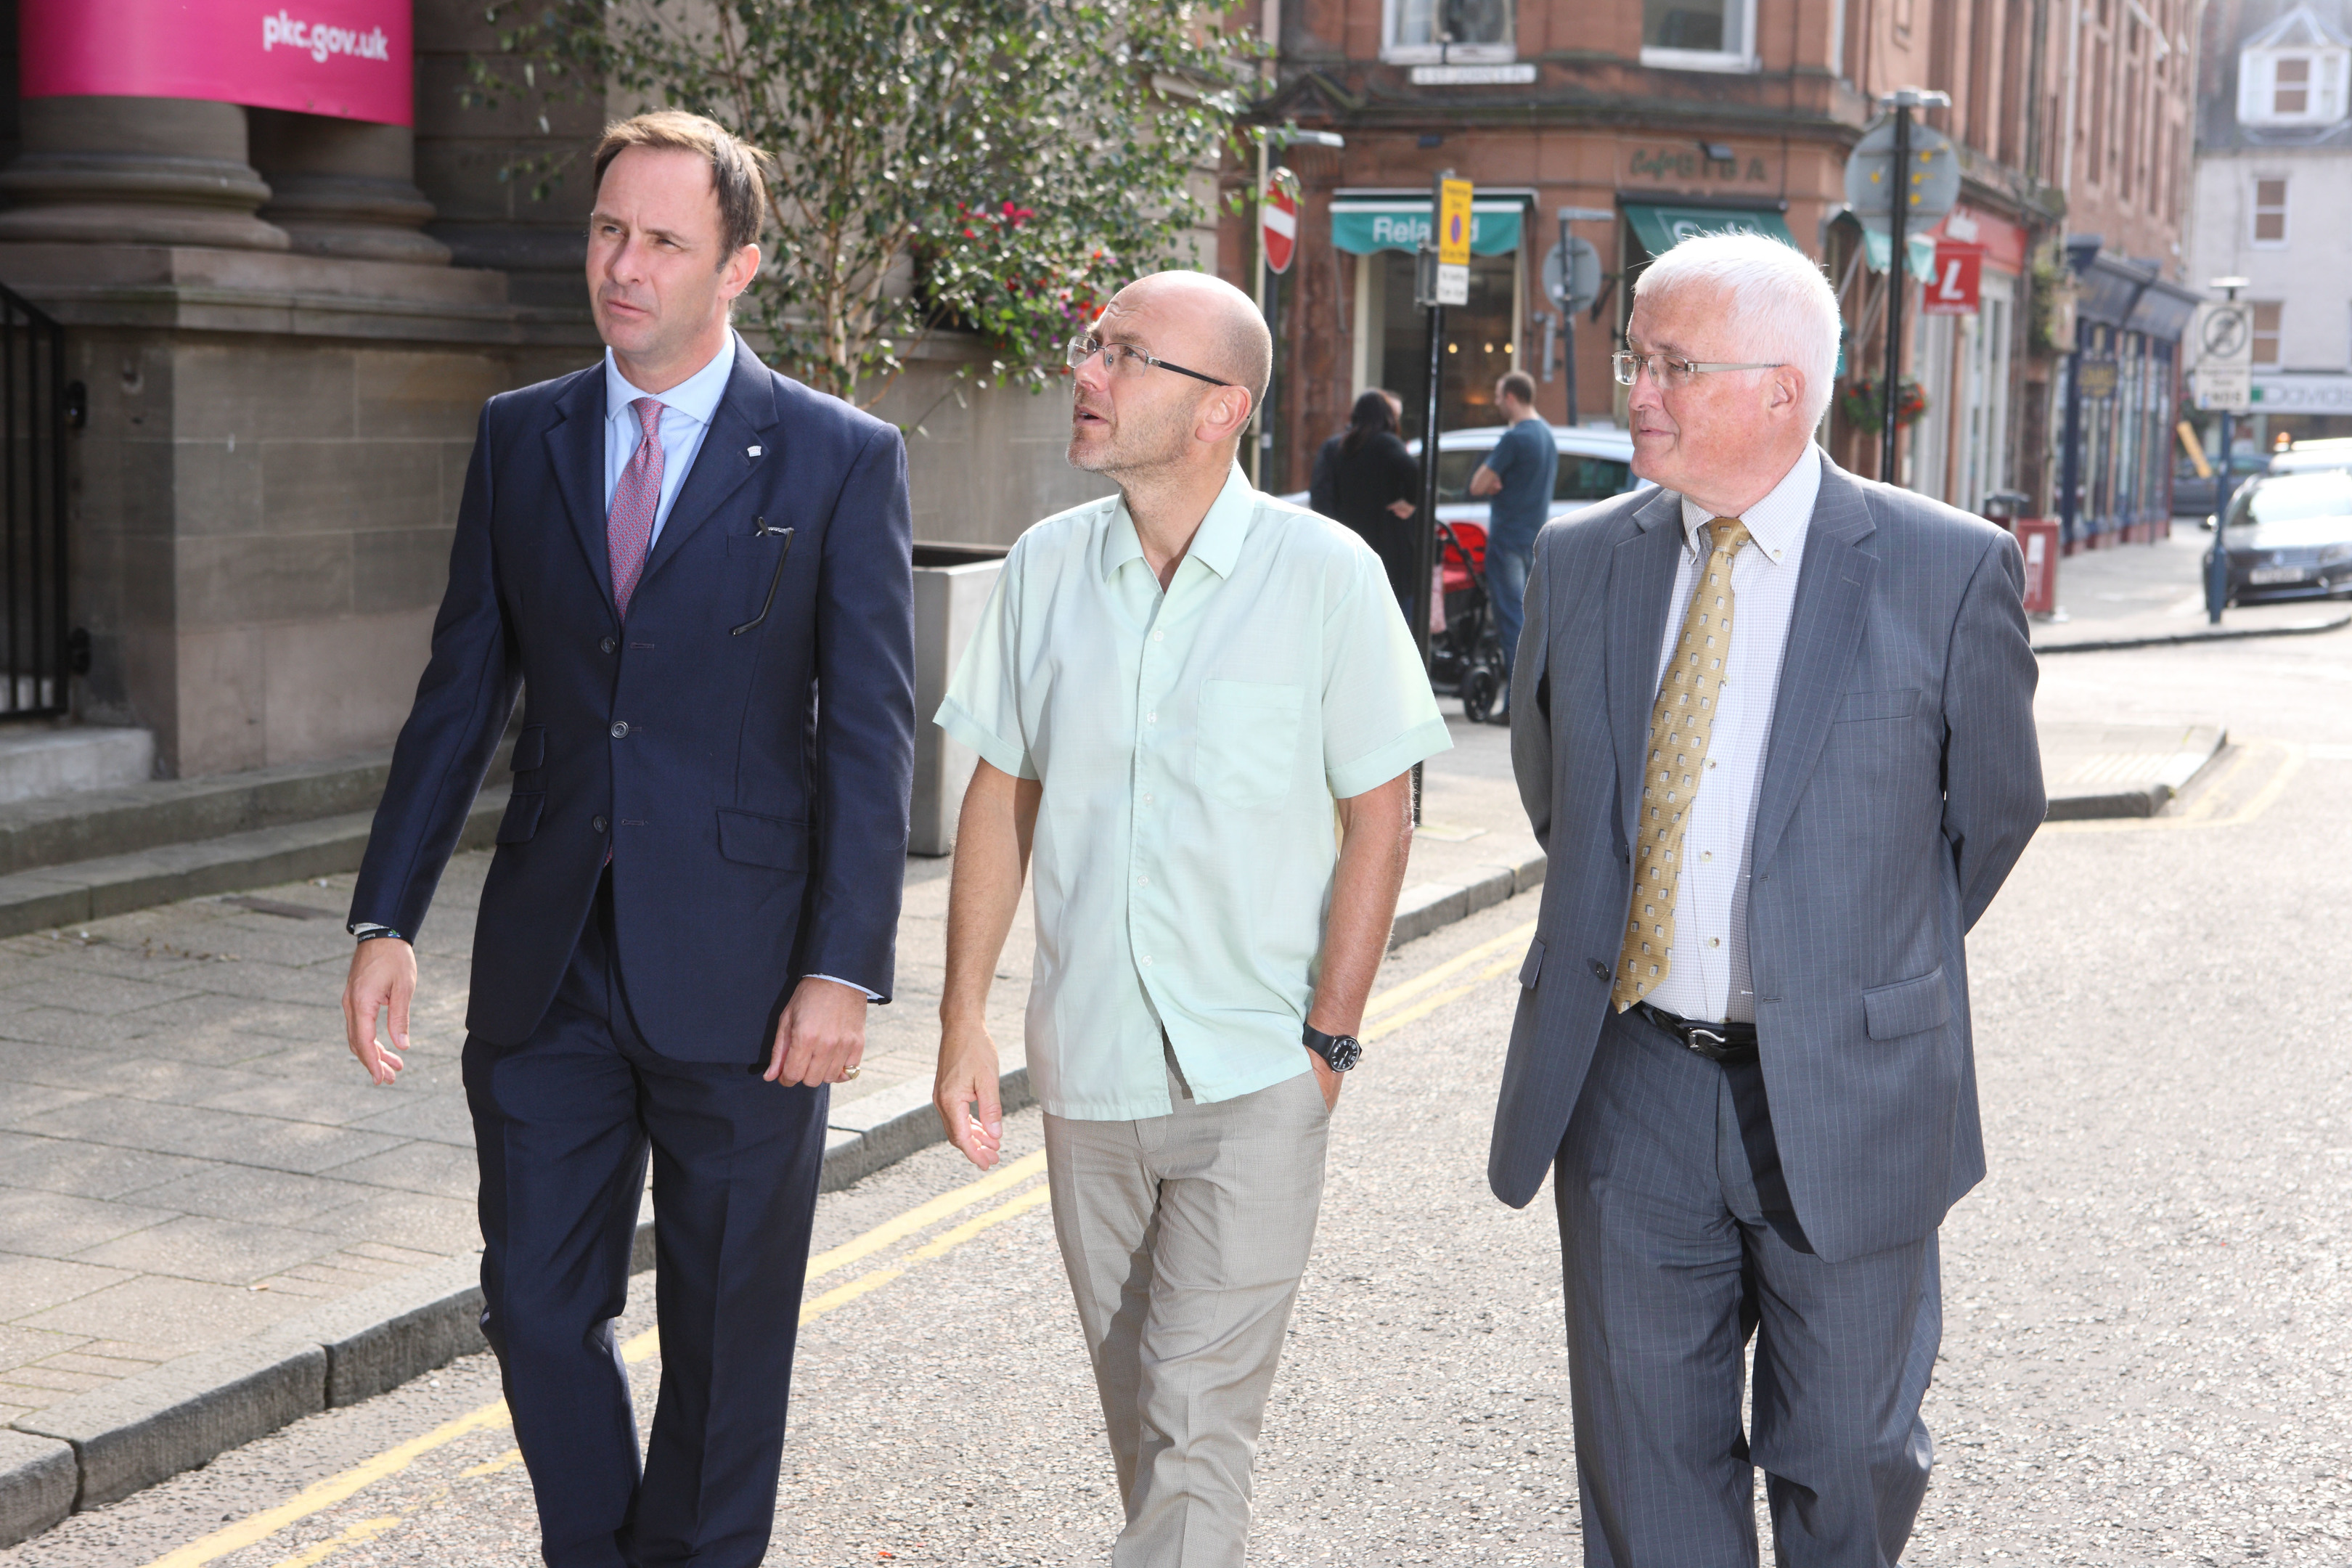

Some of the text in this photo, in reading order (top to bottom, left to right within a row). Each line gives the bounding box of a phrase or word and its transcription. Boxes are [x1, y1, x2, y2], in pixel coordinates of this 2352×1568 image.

[262, 8, 390, 63] pkc.gov.uk
[1373, 216, 1480, 244] Relad
[1939, 259, 1965, 300] L
